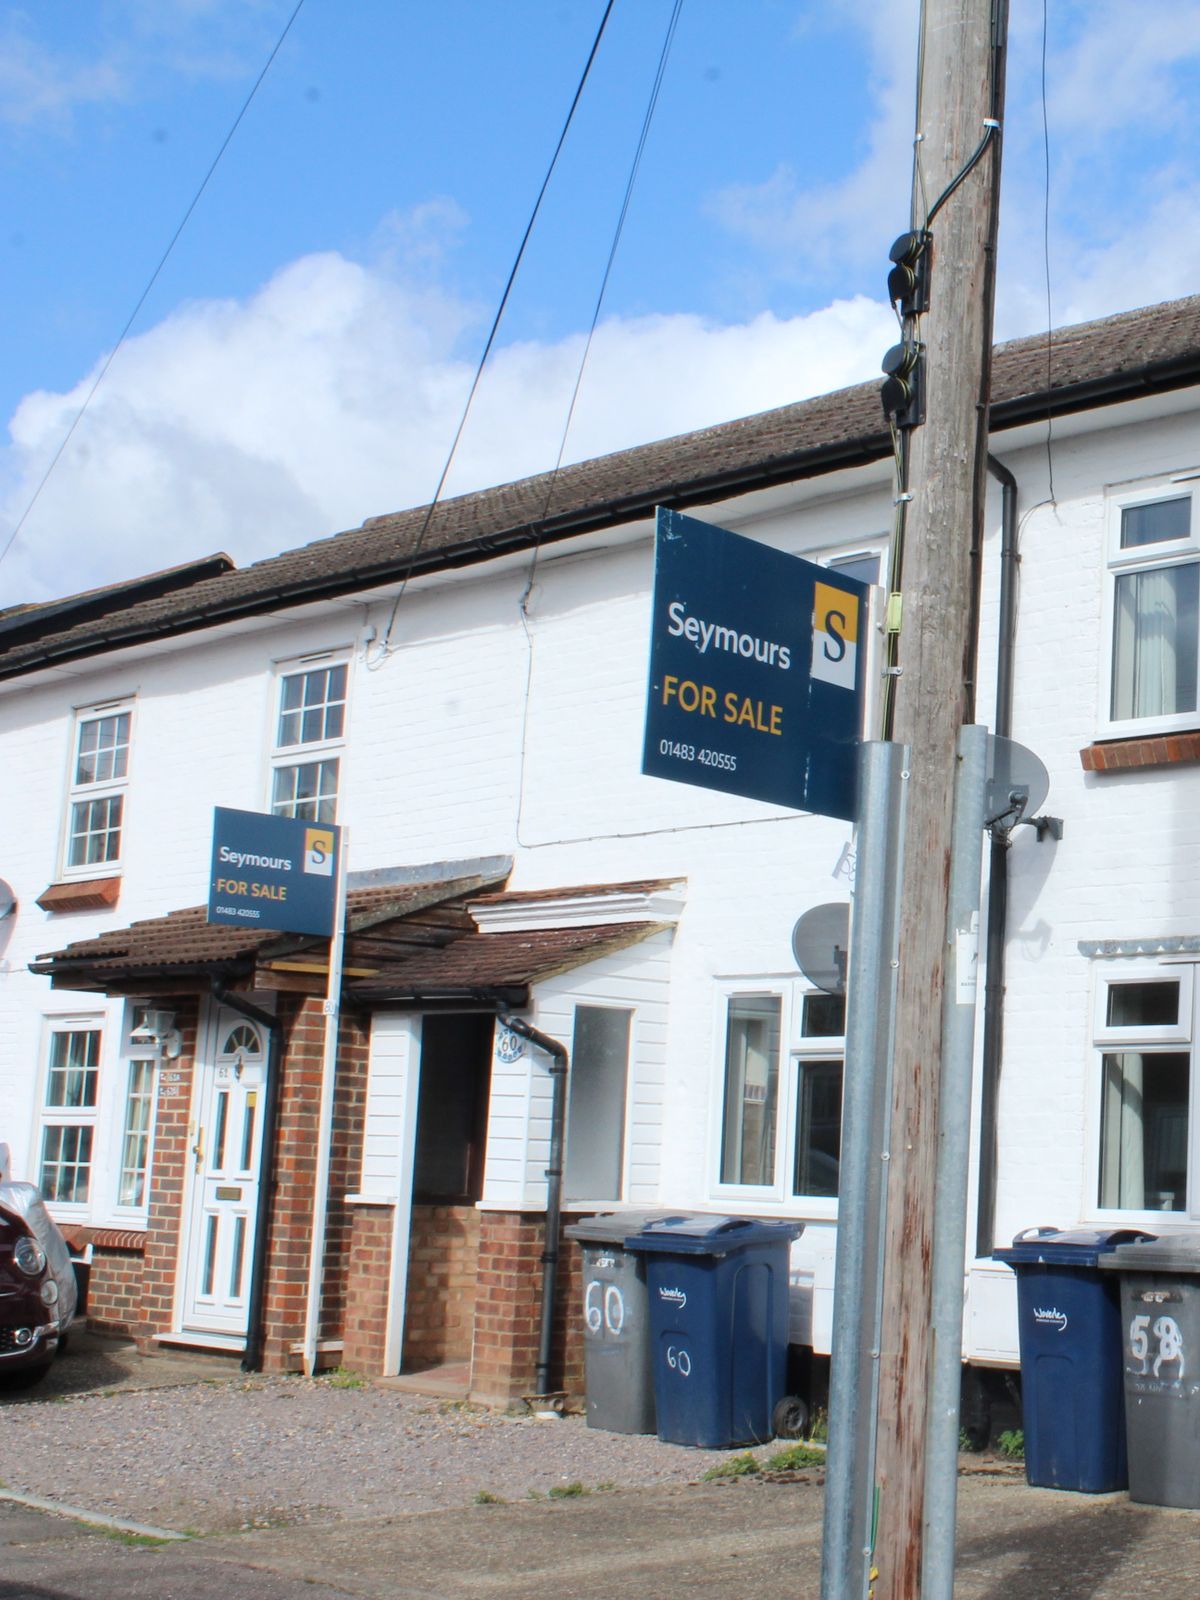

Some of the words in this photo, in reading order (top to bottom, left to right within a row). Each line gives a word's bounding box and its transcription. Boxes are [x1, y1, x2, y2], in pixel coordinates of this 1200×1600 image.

[667, 601, 791, 670] Seymours
[823, 610, 847, 662] S
[662, 675, 717, 719] FOR
[723, 692, 784, 736] SALE
[660, 739, 695, 761] 01483
[697, 748, 737, 771] 420555
[219, 846, 292, 871] Seymours
[312, 839, 327, 865] S
[216, 878, 248, 896] FOR
[251, 883, 288, 901] SALE
[501, 1035, 517, 1052] 60
[585, 1280, 625, 1335] 60
[667, 1345, 692, 1377] 60
